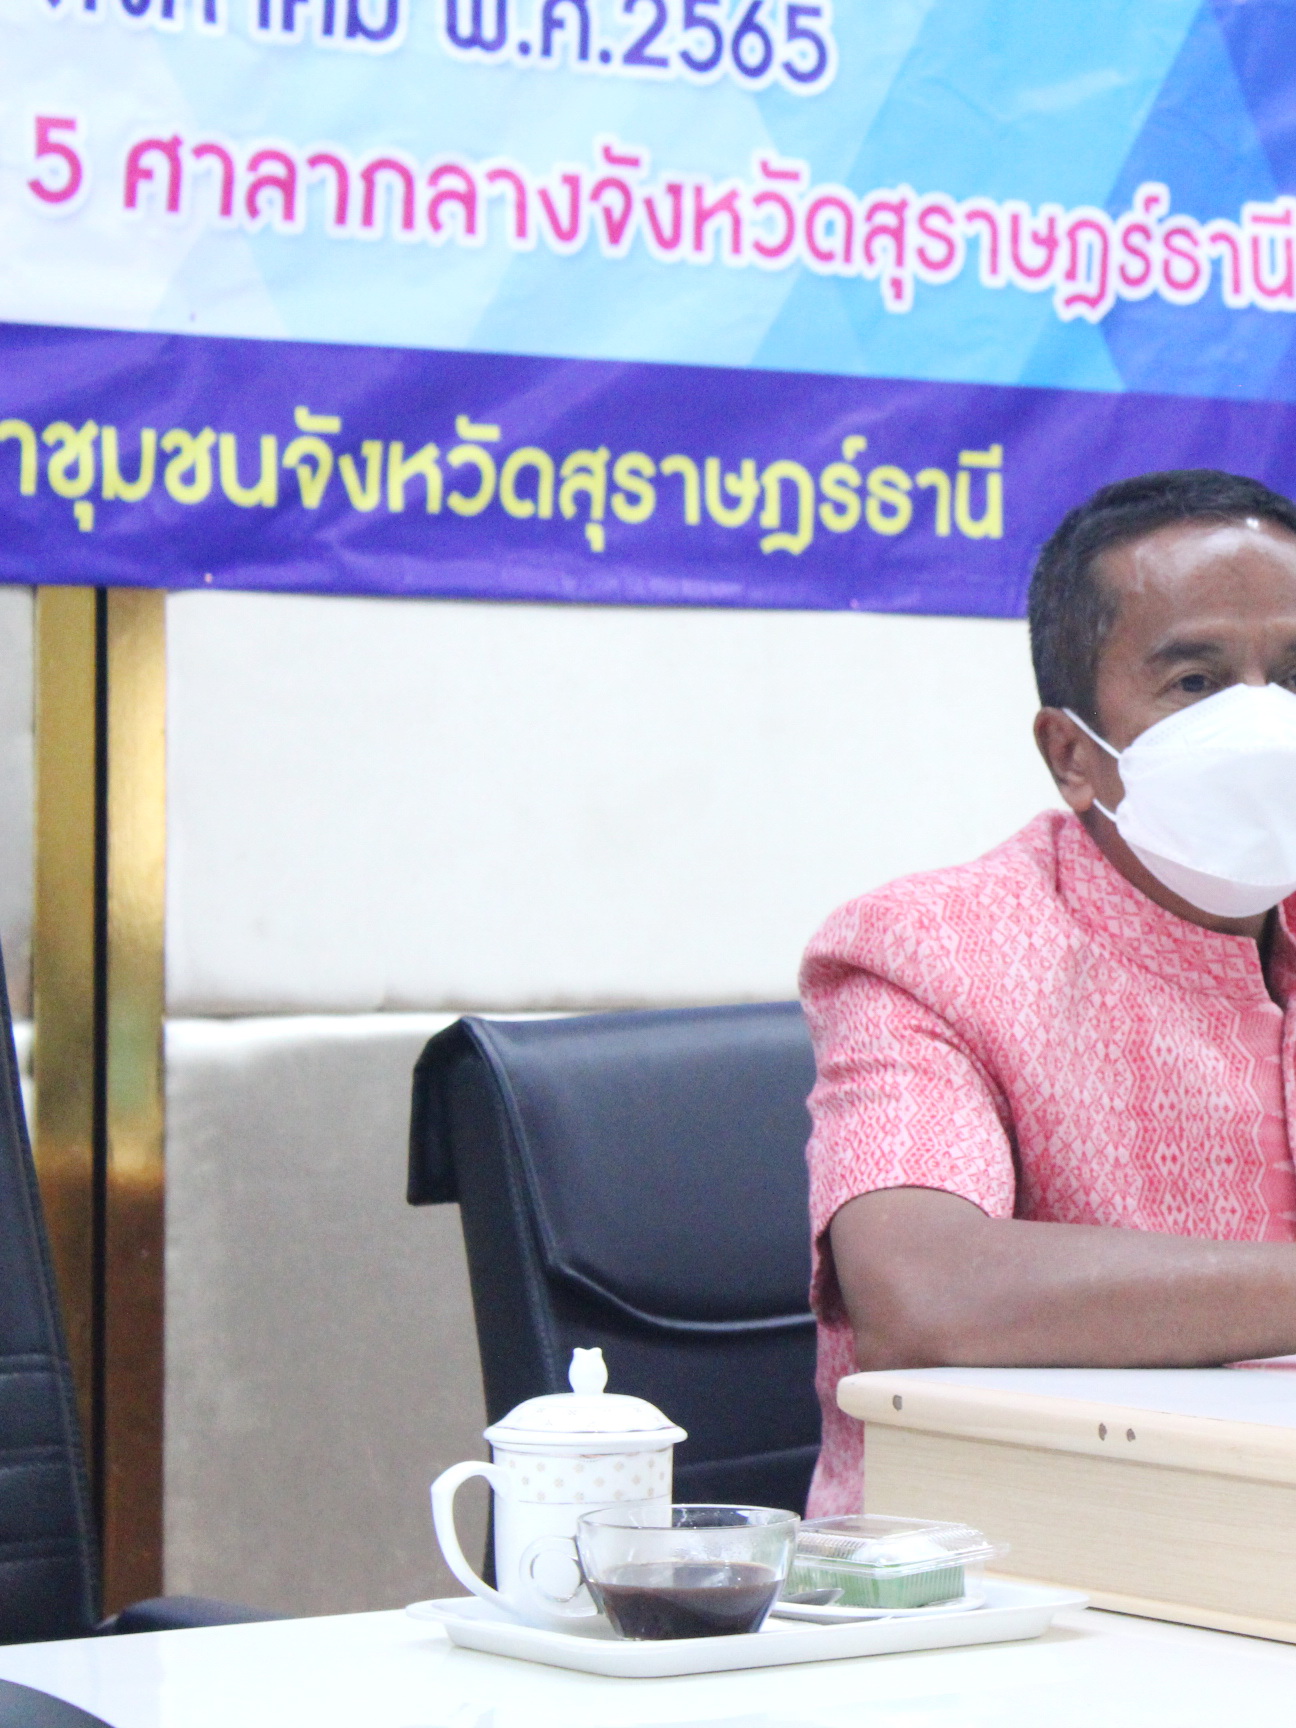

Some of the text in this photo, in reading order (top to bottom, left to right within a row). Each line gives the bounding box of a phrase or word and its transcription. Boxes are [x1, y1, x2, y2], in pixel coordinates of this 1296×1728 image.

[28, 115, 1296, 309] 5 ศาลากลางจังหวัดสุราษฎร์ธานี
